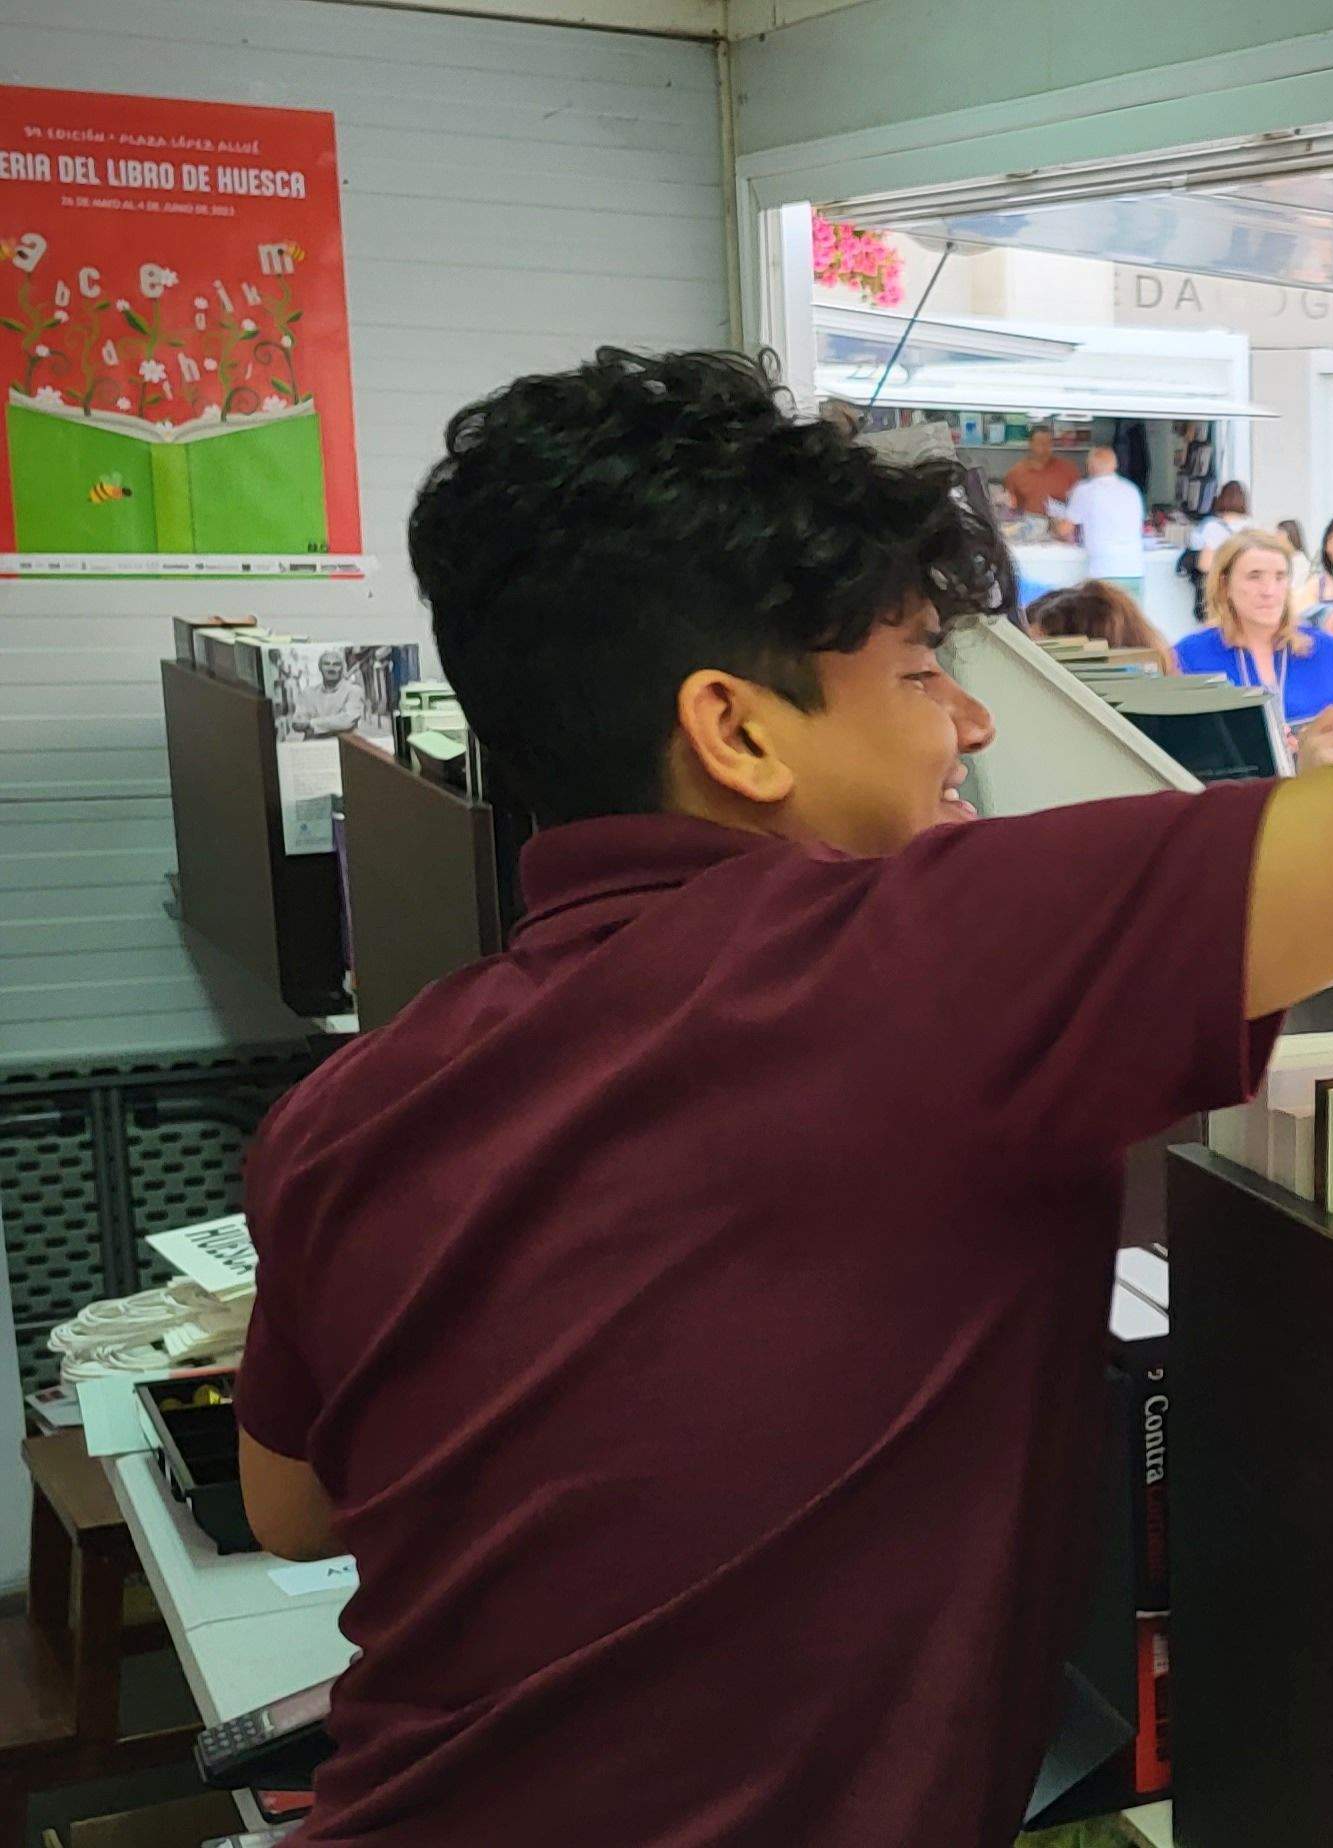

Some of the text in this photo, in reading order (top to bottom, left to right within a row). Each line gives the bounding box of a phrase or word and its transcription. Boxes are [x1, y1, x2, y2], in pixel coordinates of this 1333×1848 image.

[120, 133, 165, 148] PLAZA
[0, 150, 306, 199] ERIA DEL LIBRO DE HUESCA
[1143, 1394, 1169, 1486] Contra
